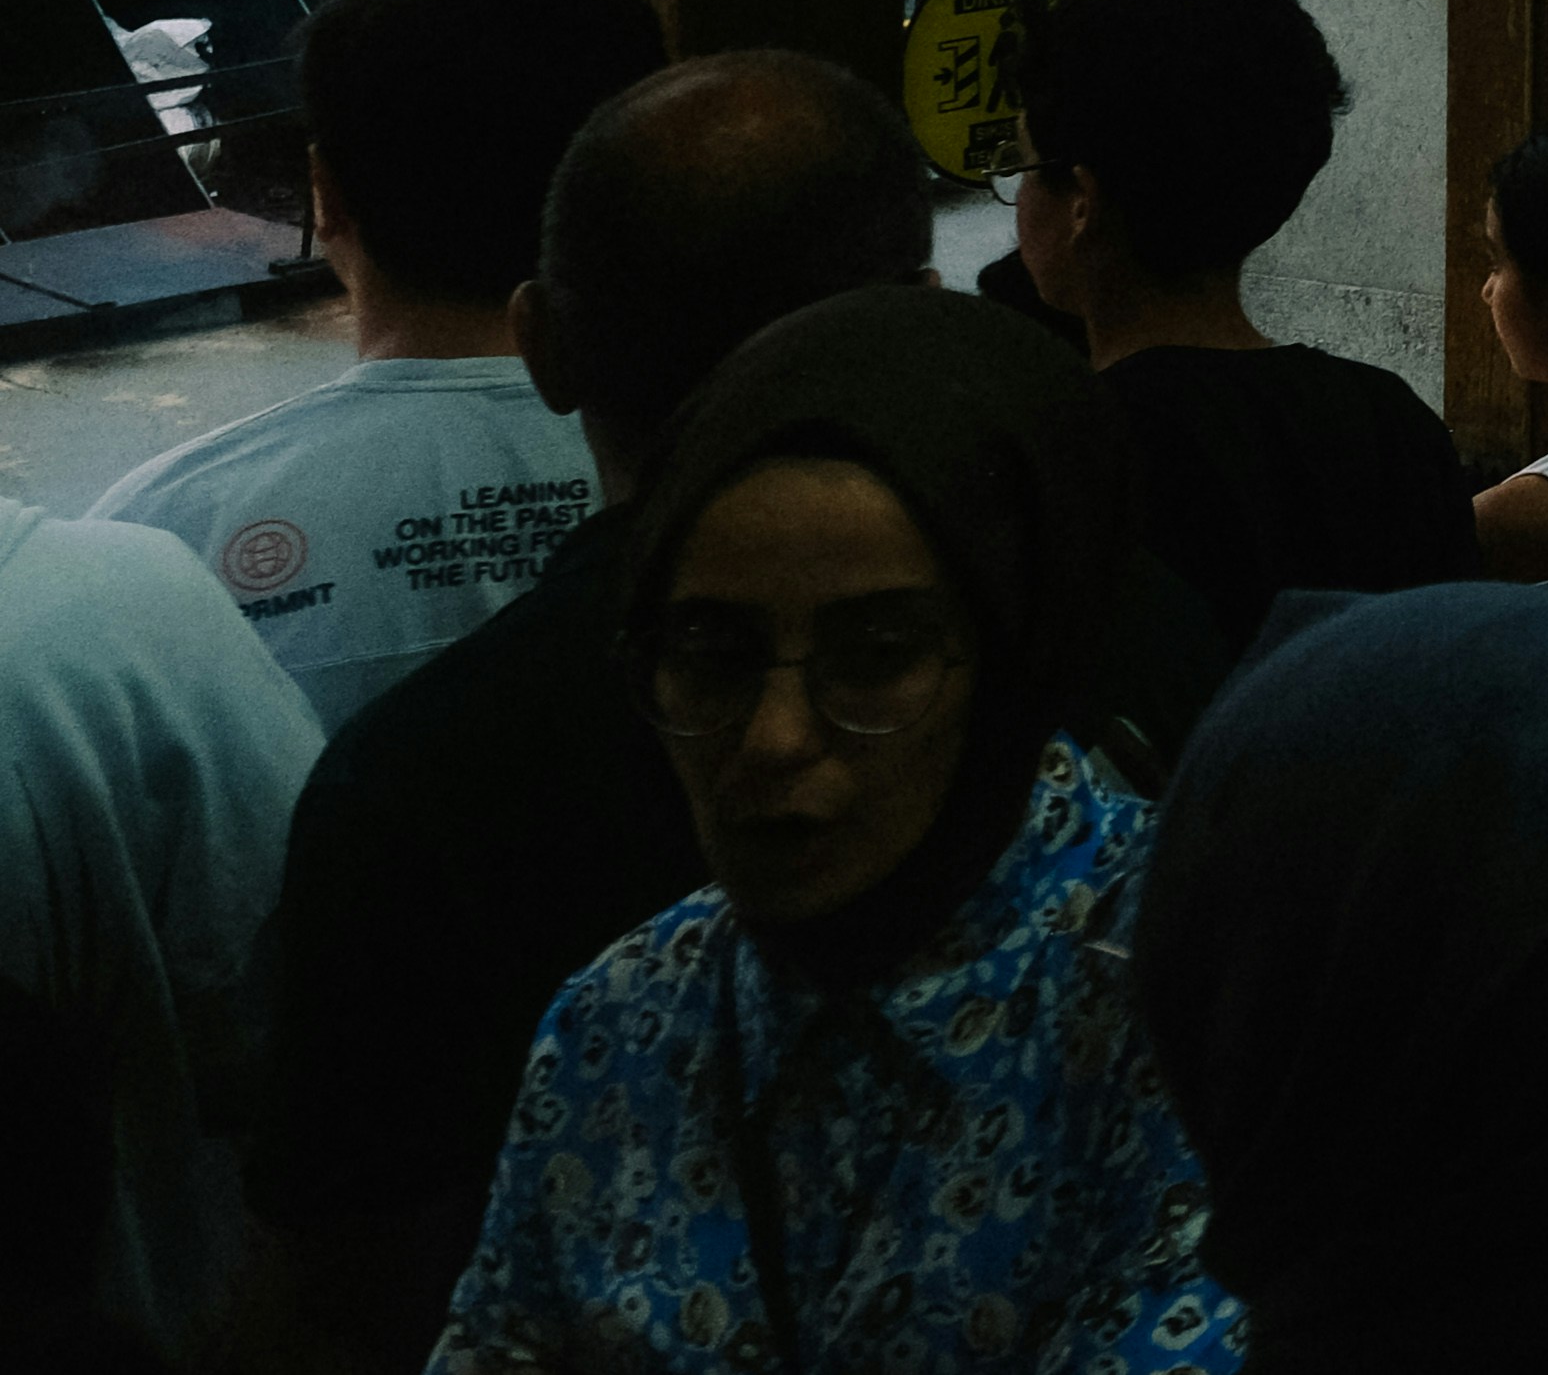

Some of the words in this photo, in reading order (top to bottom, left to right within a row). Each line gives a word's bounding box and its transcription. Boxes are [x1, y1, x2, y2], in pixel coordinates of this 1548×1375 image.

[460, 479, 590, 510] LEANING
[395, 517, 443, 541] ON
[451, 510, 508, 534] THE
[516, 502, 590, 530] PAST
[372, 534, 520, 570] WORKING
[530, 529, 568, 552] FO
[406, 562, 466, 590] THE
[474, 556, 548, 584] FUTU
